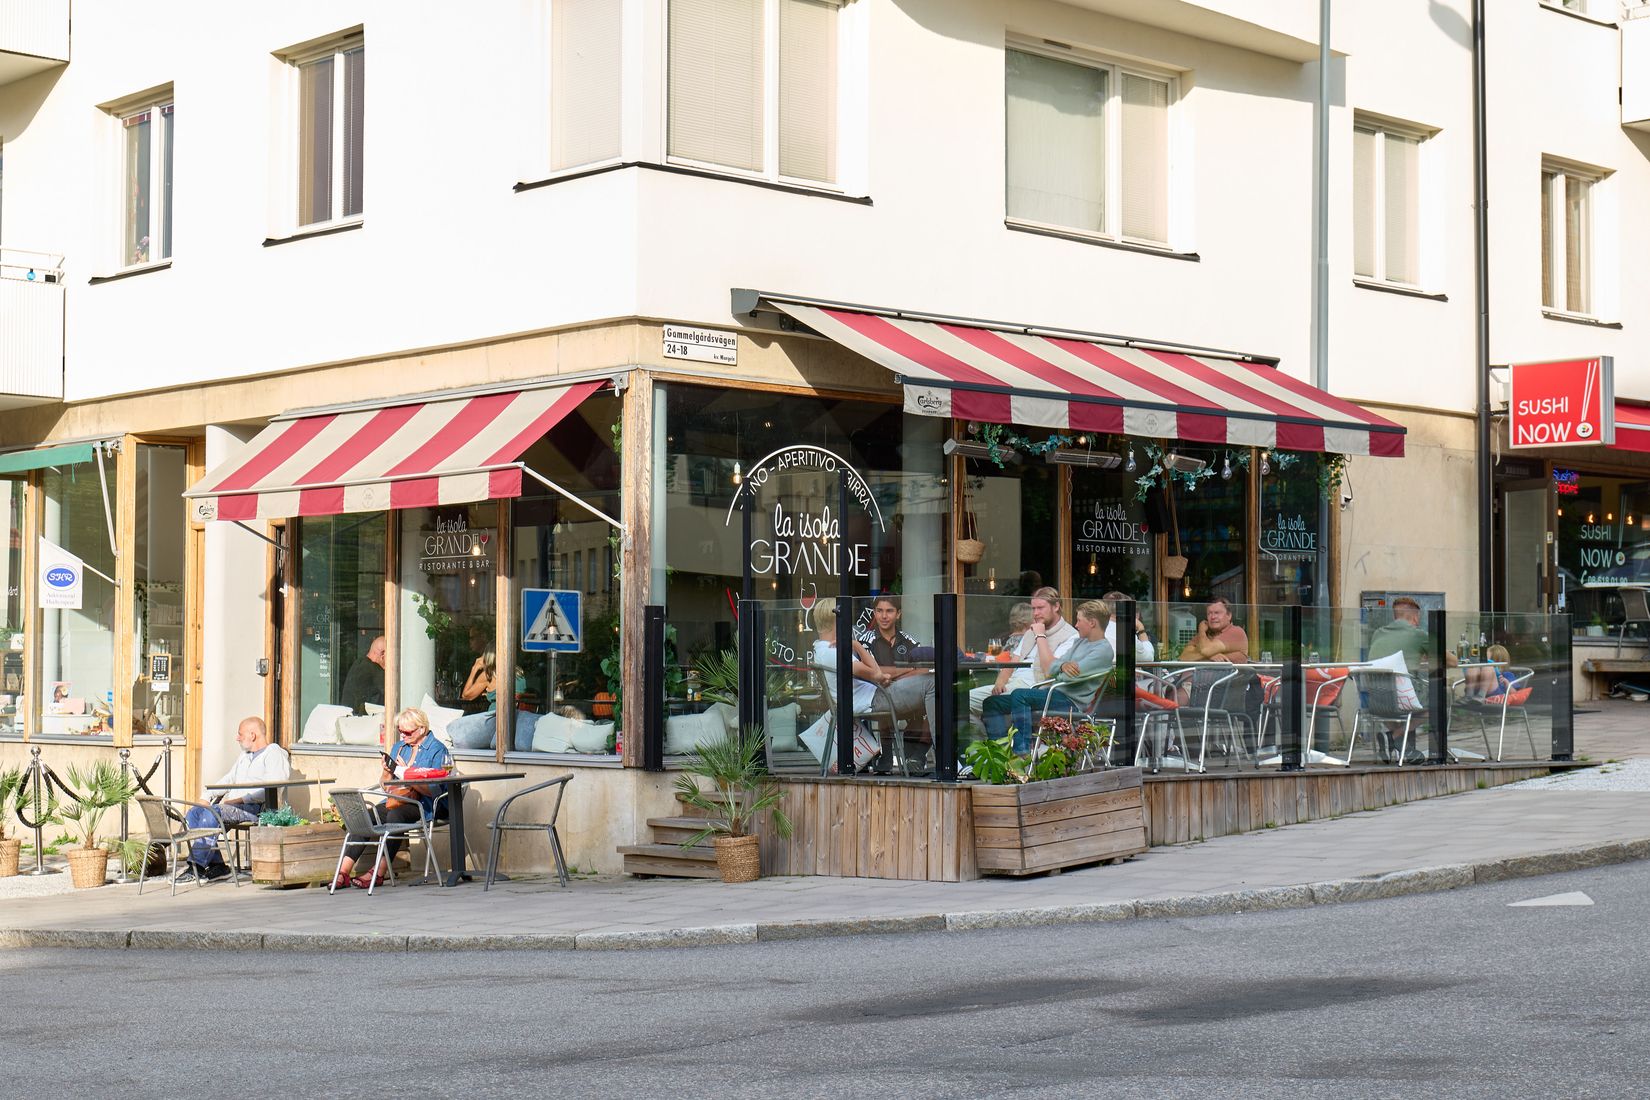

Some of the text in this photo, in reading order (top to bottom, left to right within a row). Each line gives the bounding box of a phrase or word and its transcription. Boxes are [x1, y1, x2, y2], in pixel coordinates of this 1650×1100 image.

[666, 327, 736, 347] Gammelgårdsvägen
[667, 344, 688, 355] 24-18
[917, 395, 943, 409] Carlsberg
[1518, 396, 1569, 416] SUSHI
[1518, 421, 1572, 444] NOW
[741, 468, 768, 496] INO
[778, 450, 836, 472] APERITIVO
[775, 503, 840, 539] la isola
[1095, 501, 1127, 521] la isola
[436, 513, 467, 534] la isola
[1082, 520, 1140, 541] GRANDE
[1277, 513, 1307, 531] la isola
[1580, 524, 1612, 540] SUSHI
[1076, 544, 1126, 555] RISTORANTE
[1136, 547, 1150, 555] BAR
[1267, 530, 1317, 549] GRANDE
[419, 561, 466, 571] RISTORANTE
[475, 559, 490, 569] BAR
[751, 539, 868, 576] GRANDE
[1580, 548, 1613, 568] NOW
[852, 607, 875, 641] ASTA
